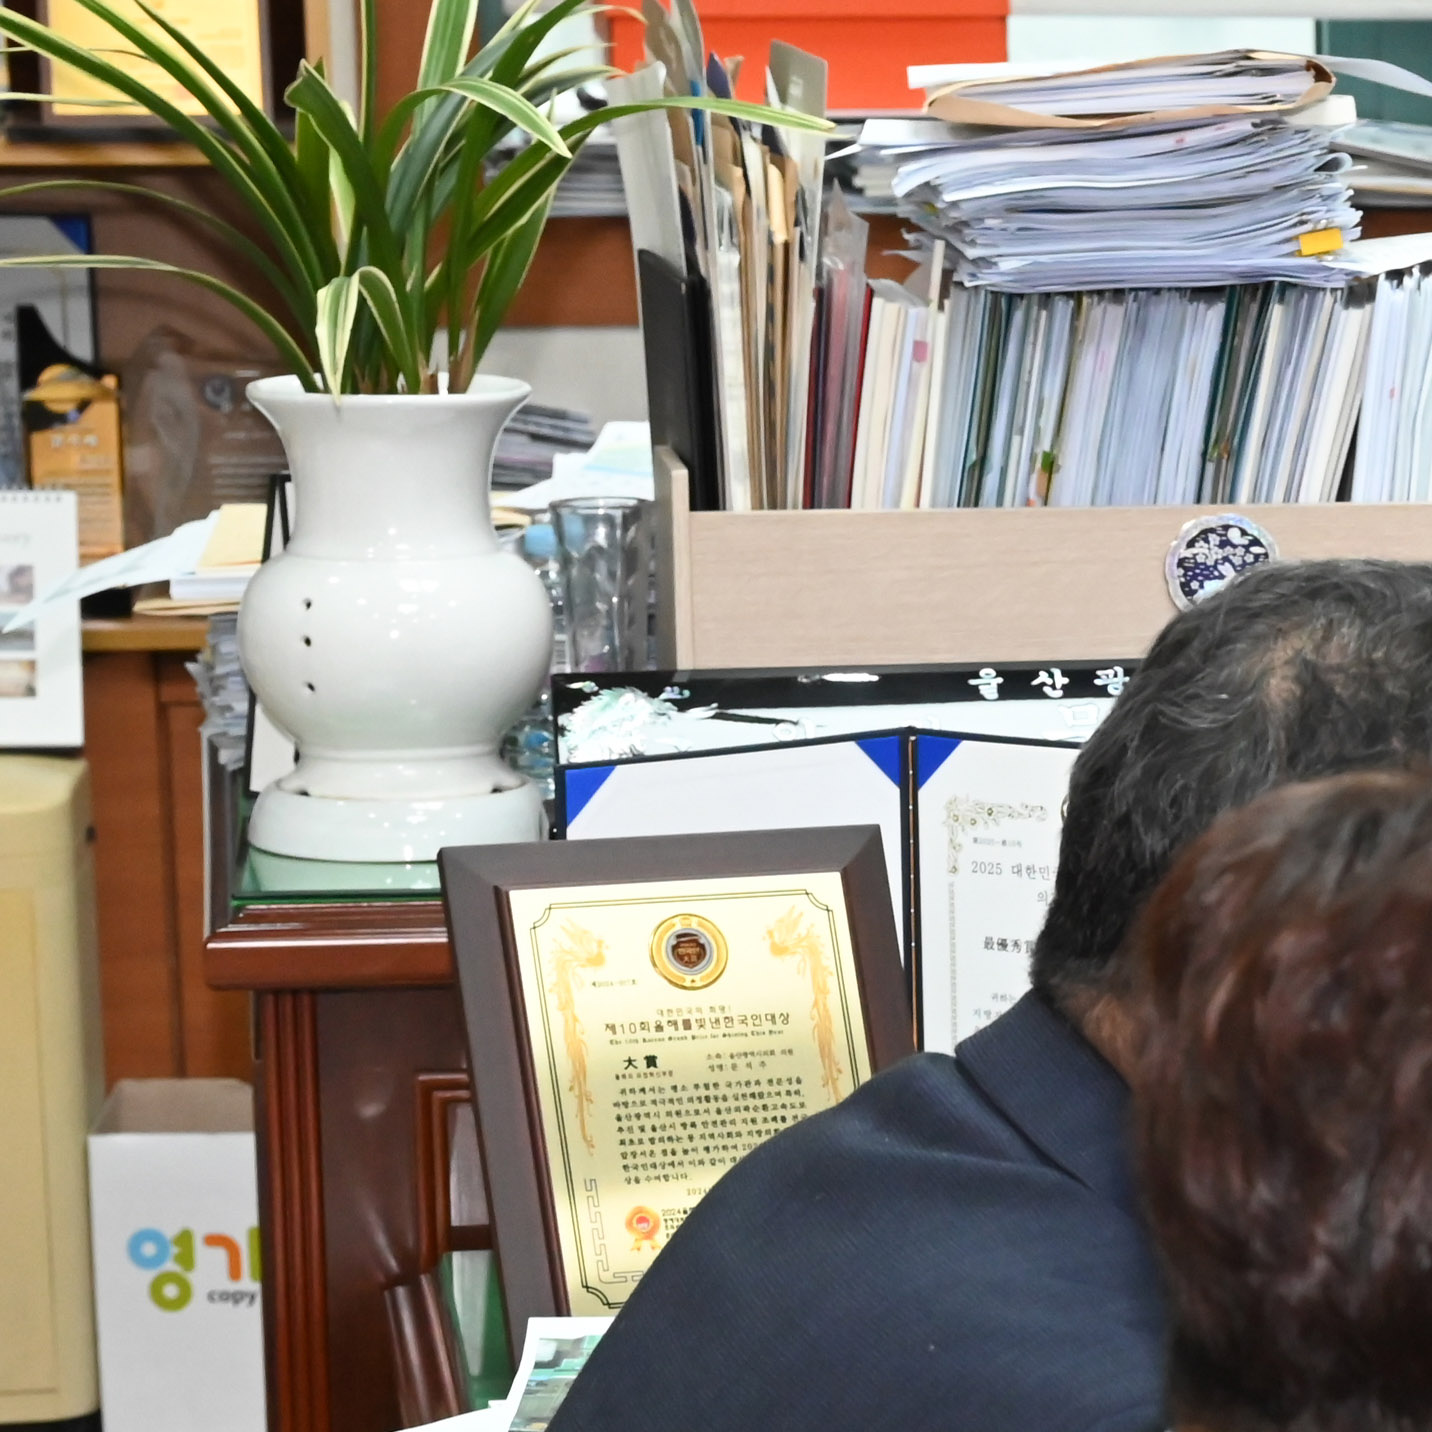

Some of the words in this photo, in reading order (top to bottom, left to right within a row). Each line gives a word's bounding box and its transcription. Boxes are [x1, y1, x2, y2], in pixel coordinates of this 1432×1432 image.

[971, 861, 1003, 876] 2025
[1011, 862, 1058, 881] 대한민
[623, 1054, 660, 1071] 大賞
[615, 1110, 661, 1123] 울산광역시
[650, 1122, 677, 1133] 울산시
[207, 1289, 259, 1309] copy
